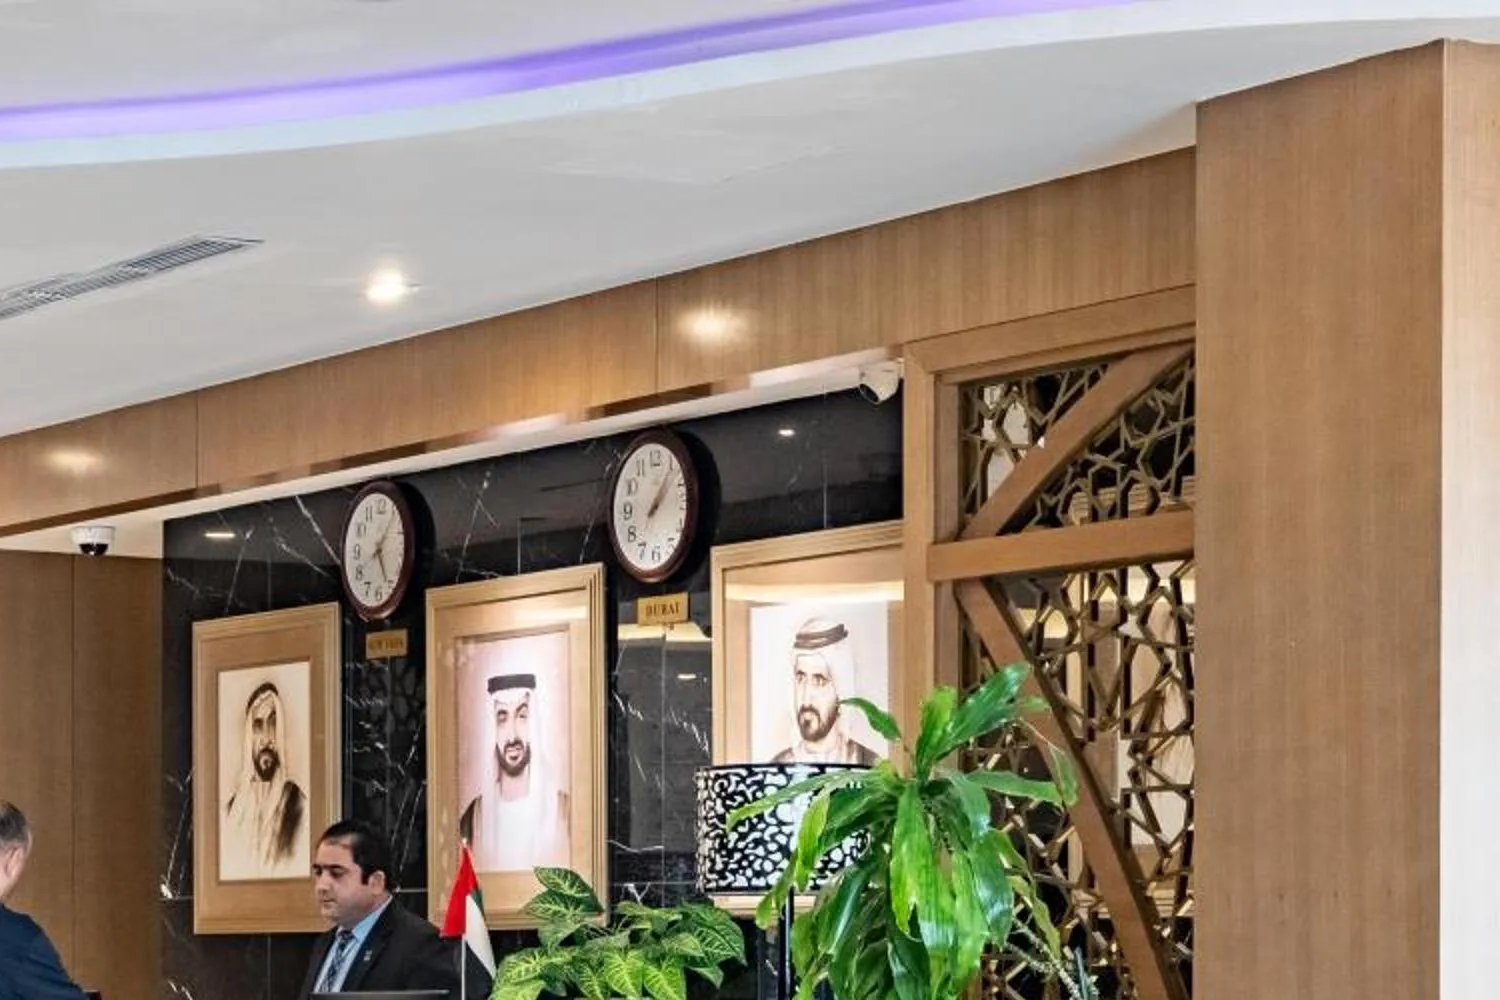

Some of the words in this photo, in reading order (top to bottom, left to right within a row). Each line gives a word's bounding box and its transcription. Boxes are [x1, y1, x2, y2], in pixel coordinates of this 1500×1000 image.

[623, 501, 633, 521] 9
[628, 525, 637, 543] 8
[354, 544, 361, 560] 9
[637, 541, 647, 560] 7
[364, 581, 372, 597] 7
[645, 602, 680, 616] DUBAI
